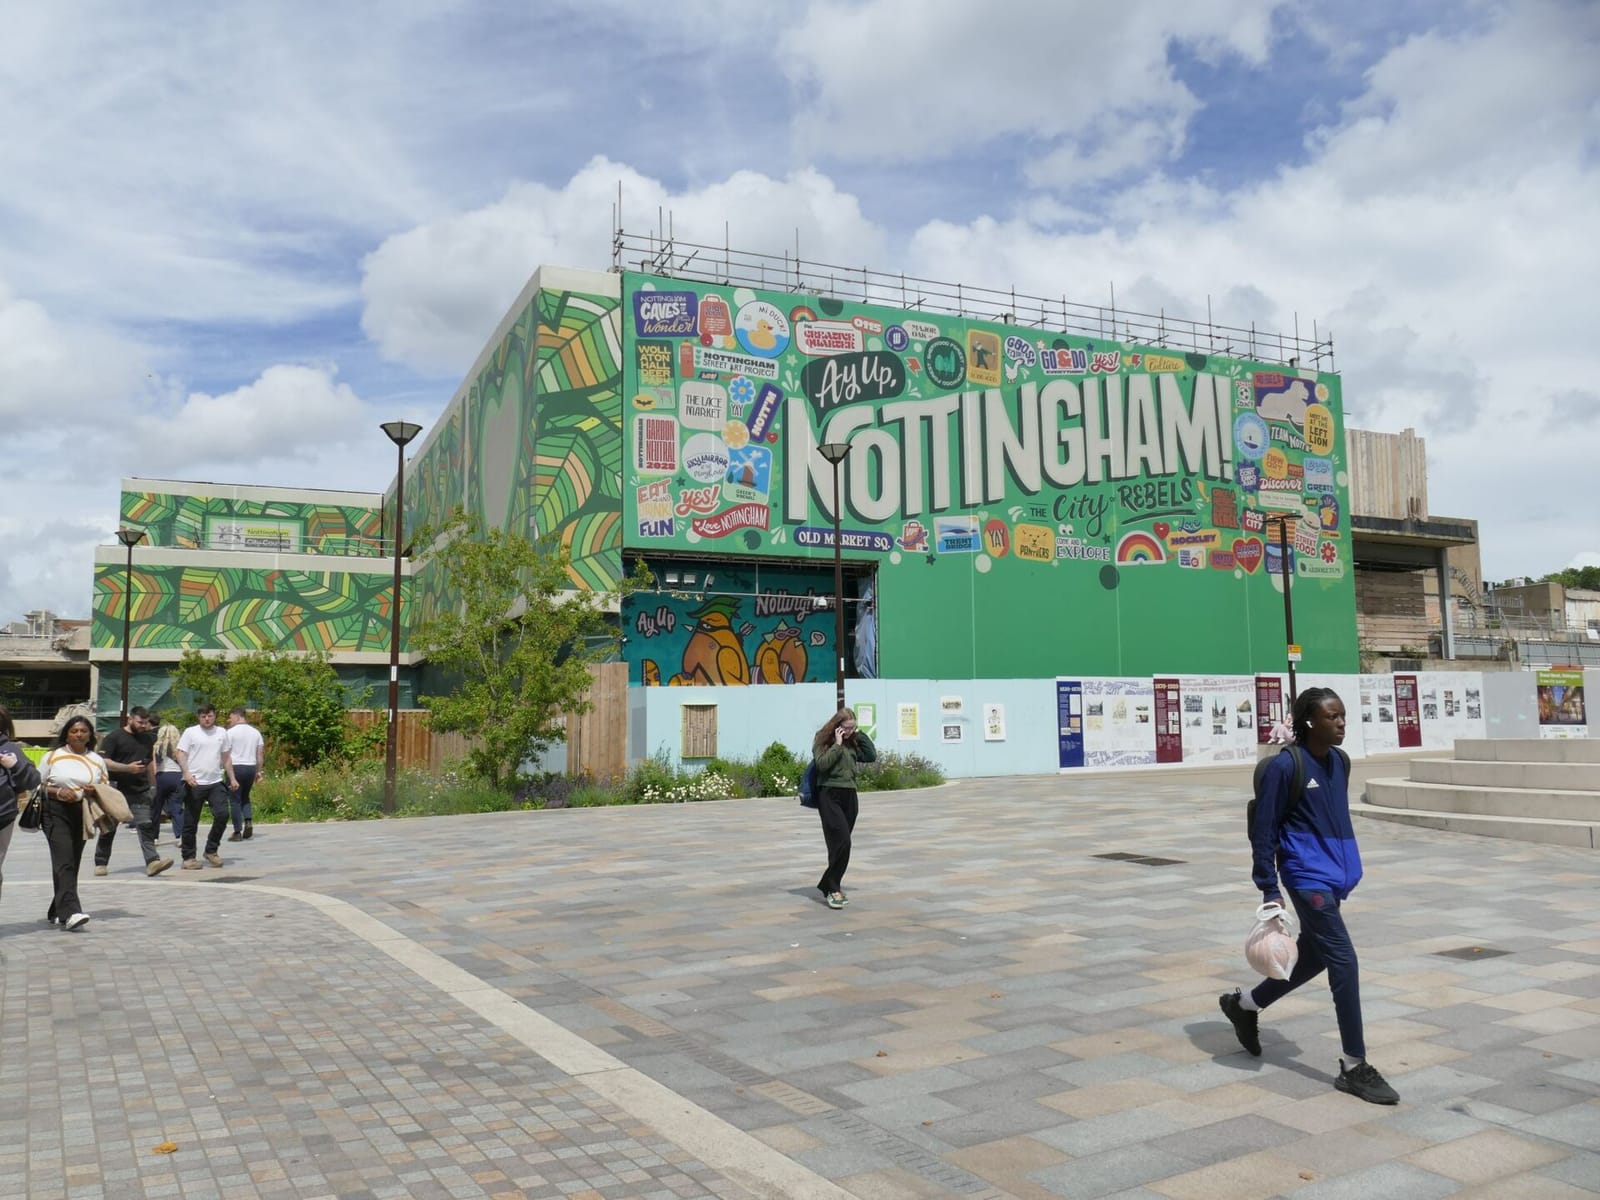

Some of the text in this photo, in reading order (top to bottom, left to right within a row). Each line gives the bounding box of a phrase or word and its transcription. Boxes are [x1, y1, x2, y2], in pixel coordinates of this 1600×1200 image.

[640, 302, 680, 321] CAVES
[643, 316, 695, 333] Wonder!
[638, 345, 671, 354] WOLL
[640, 353, 670, 362] ATON
[704, 351, 775, 370] NOTTINGHAM
[1090, 352, 1119, 372] YES!
[641, 361, 670, 370] HALL
[641, 369, 671, 377] DEER
[703, 358, 728, 370] STREET
[744, 366, 776, 378] PROJECT
[815, 356, 897, 408] Ay Up,
[686, 394, 722, 408] THE LACE
[685, 405, 721, 419] MARKET
[731, 402, 744, 417] YAY
[1271, 426, 1290, 442] TEAM
[1309, 427, 1328, 437] LEFT
[783, 373, 1232, 523] NOTTINGHAM!
[1309, 437, 1328, 448] LION
[646, 462, 676, 470] 2028
[638, 479, 671, 504] EAT
[1260, 477, 1303, 491] Discover
[676, 484, 721, 516] YES!
[1030, 507, 1047, 518] THE
[1053, 494, 1109, 538] City
[1117, 478, 1192, 512] REBELS
[698, 505, 767, 534] Love NOTTINGHAM
[1246, 510, 1264, 522] ROCK
[640, 518, 673, 536] FUN
[1178, 516, 1203, 534] Love
[1246, 519, 1263, 531] CITY
[798, 531, 891, 551] OLD MRKET SQ.
[944, 537, 973, 546] TRENT
[988, 527, 1006, 548] YAY
[1296, 533, 1317, 547] STREET
[1020, 545, 1050, 560] PANTHERS
[1056, 545, 1110, 560] EXPLORE
[1295, 543, 1317, 556] FOOD
[637, 604, 676, 636] Ay Up
